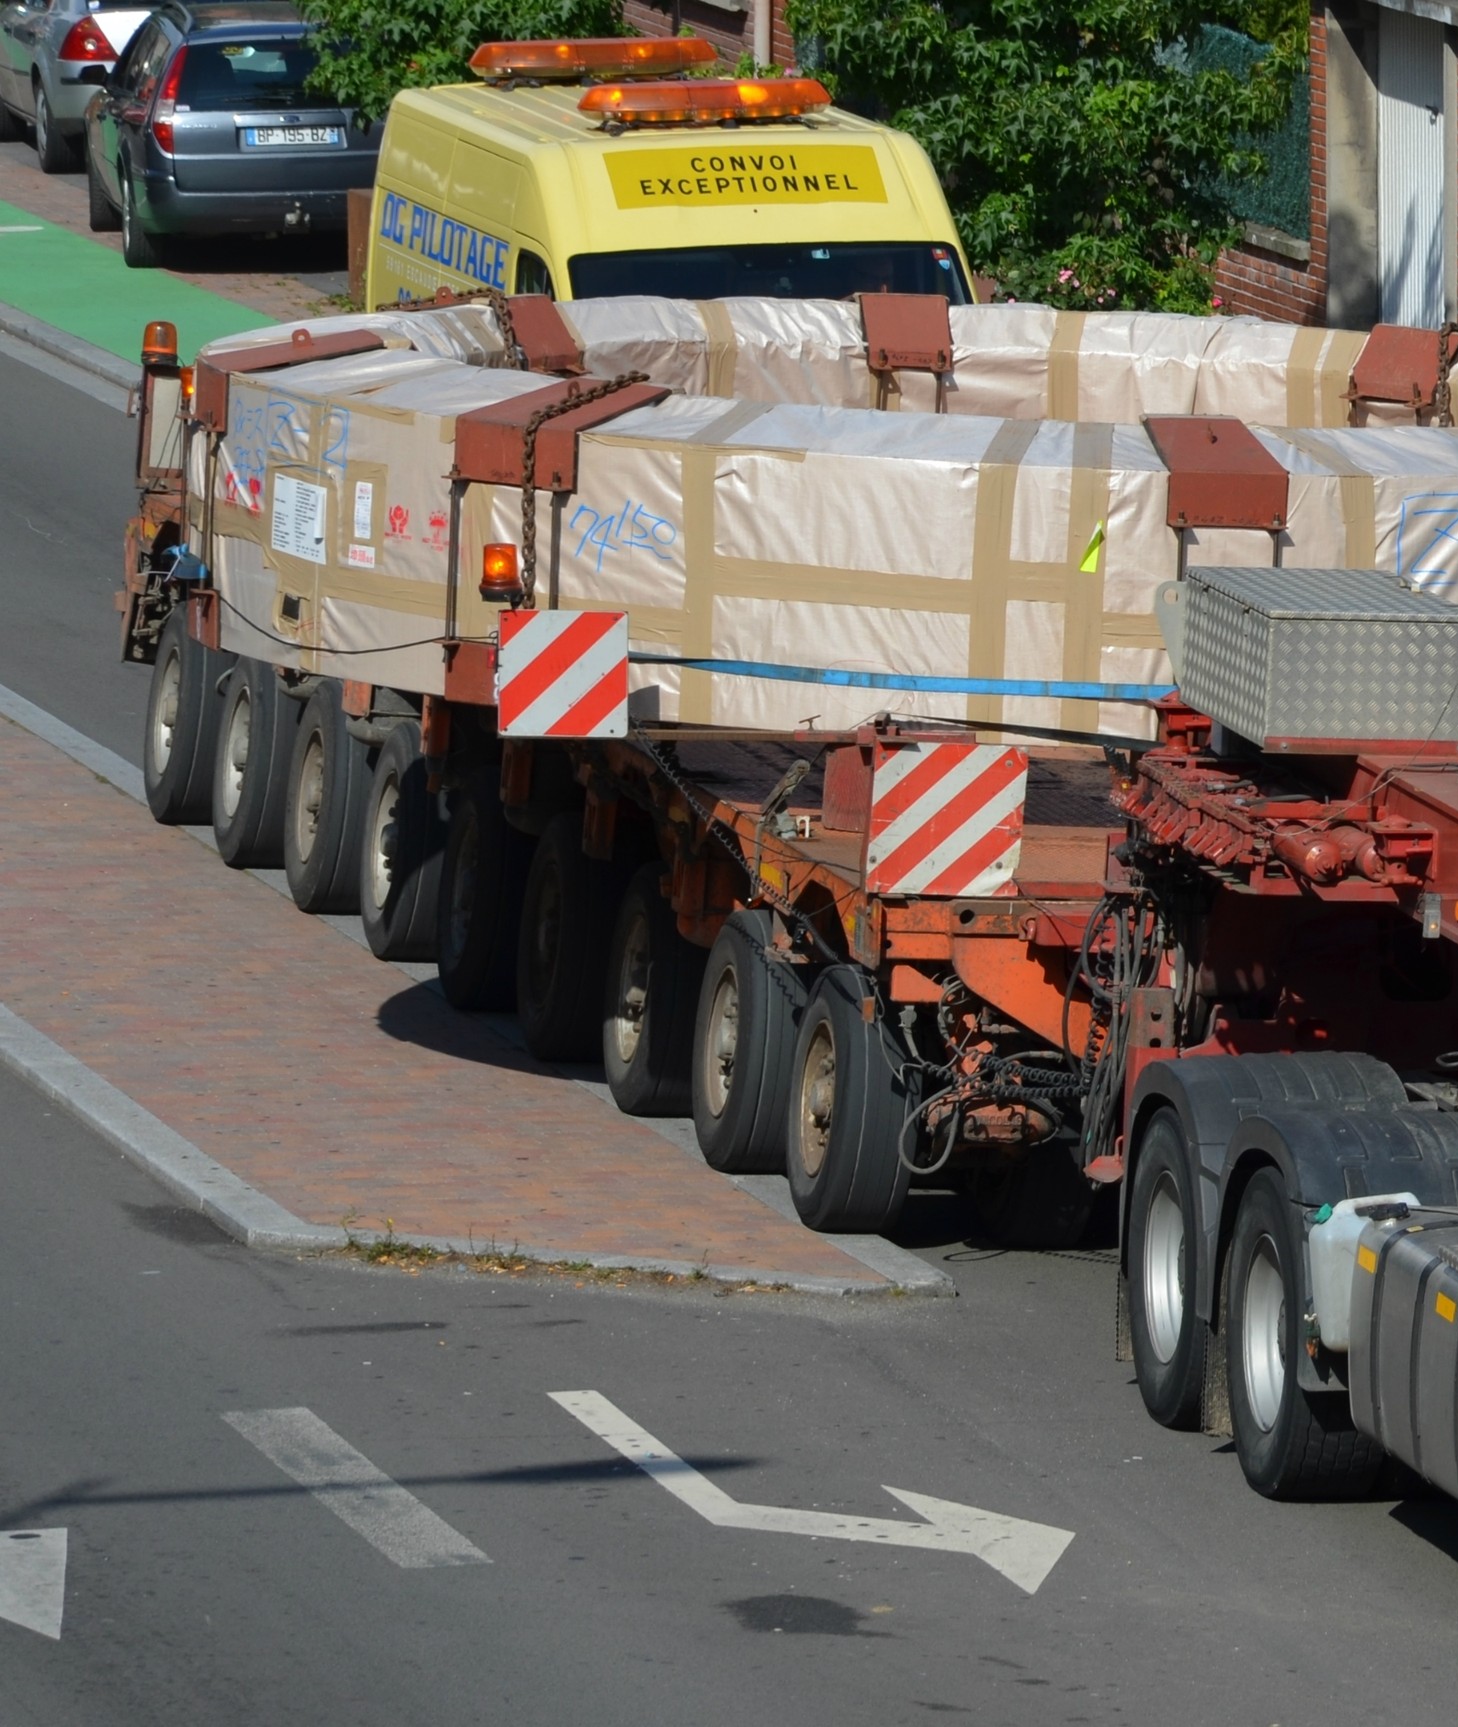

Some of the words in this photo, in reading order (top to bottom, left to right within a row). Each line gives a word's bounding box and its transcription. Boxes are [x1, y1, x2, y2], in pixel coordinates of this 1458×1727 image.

[690, 155, 798, 173] CONVOI
[639, 174, 859, 196] EXCEPTIONNEL
[408, 204, 510, 292] PILOTAGE
